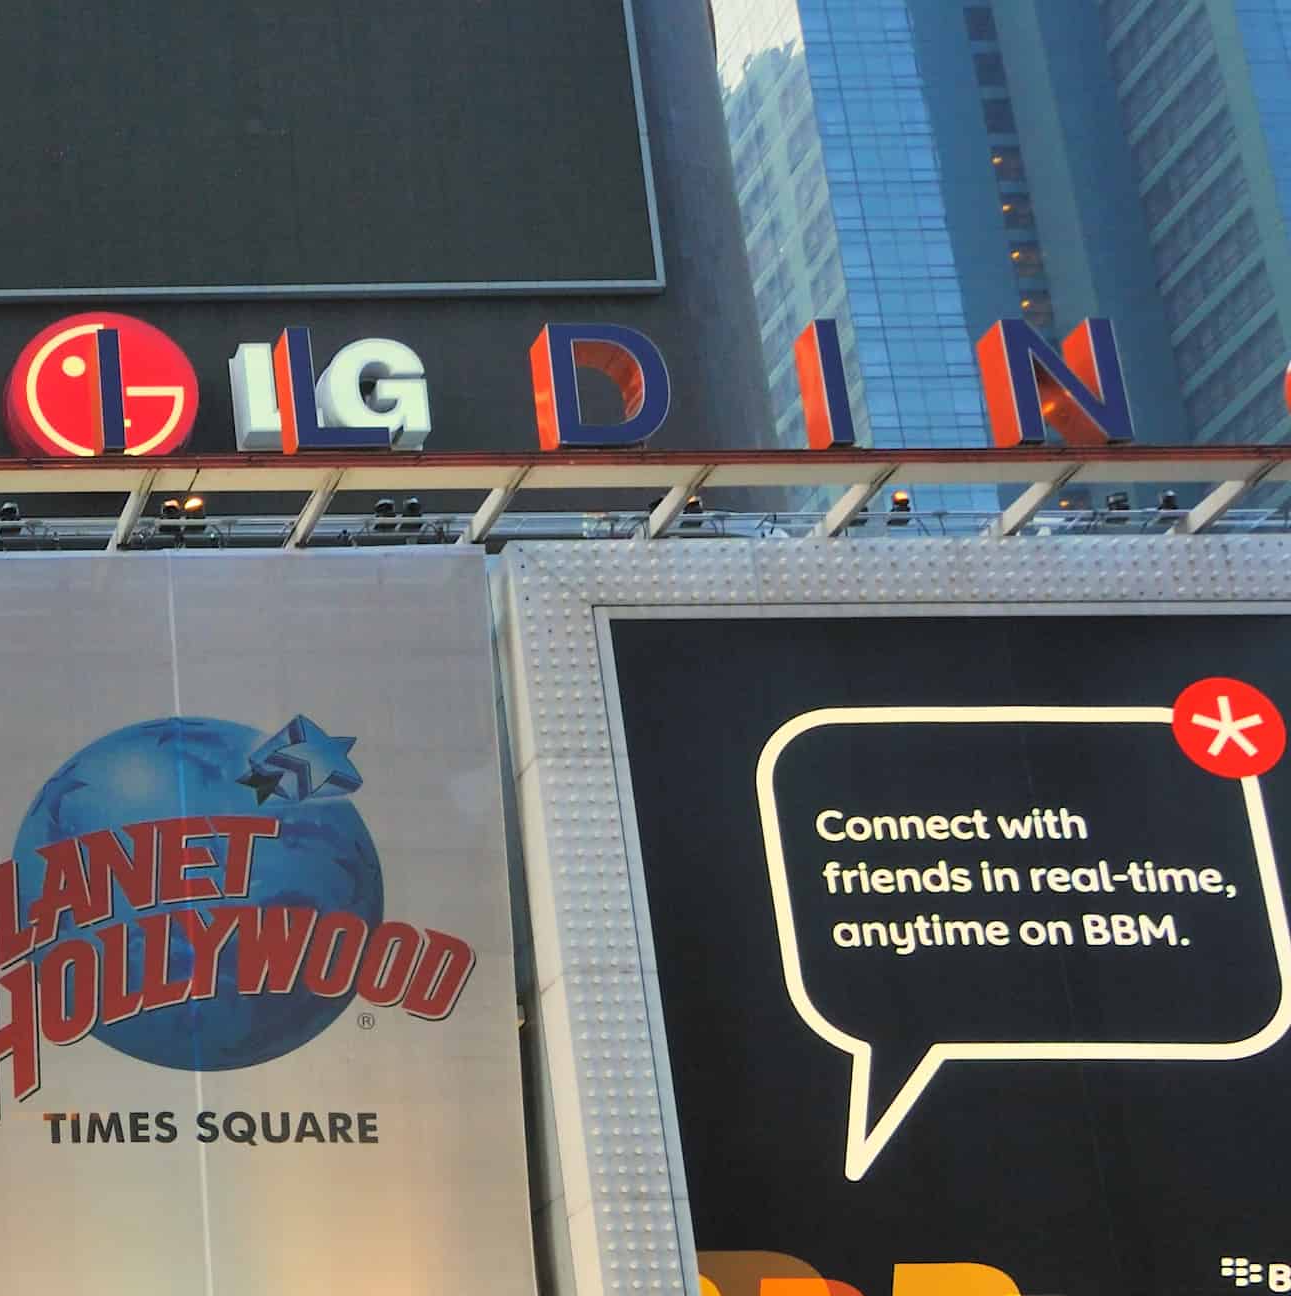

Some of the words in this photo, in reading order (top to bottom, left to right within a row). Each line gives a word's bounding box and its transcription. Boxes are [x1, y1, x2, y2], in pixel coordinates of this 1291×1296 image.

[229, 338, 431, 451] LG
[815, 808, 990, 842] Connect
[997, 808, 1088, 840] with
[823, 860, 972, 894] friends
[980, 860, 1020, 892] in
[1029, 860, 1237, 898] real-time,
[832, 915, 1010, 955] anytime
[1019, 920, 1072, 946] on
[1082, 914, 1190, 947] BBM.
[43, 1112, 177, 1144] TIMES
[196, 1112, 379, 1144] SQUARE
